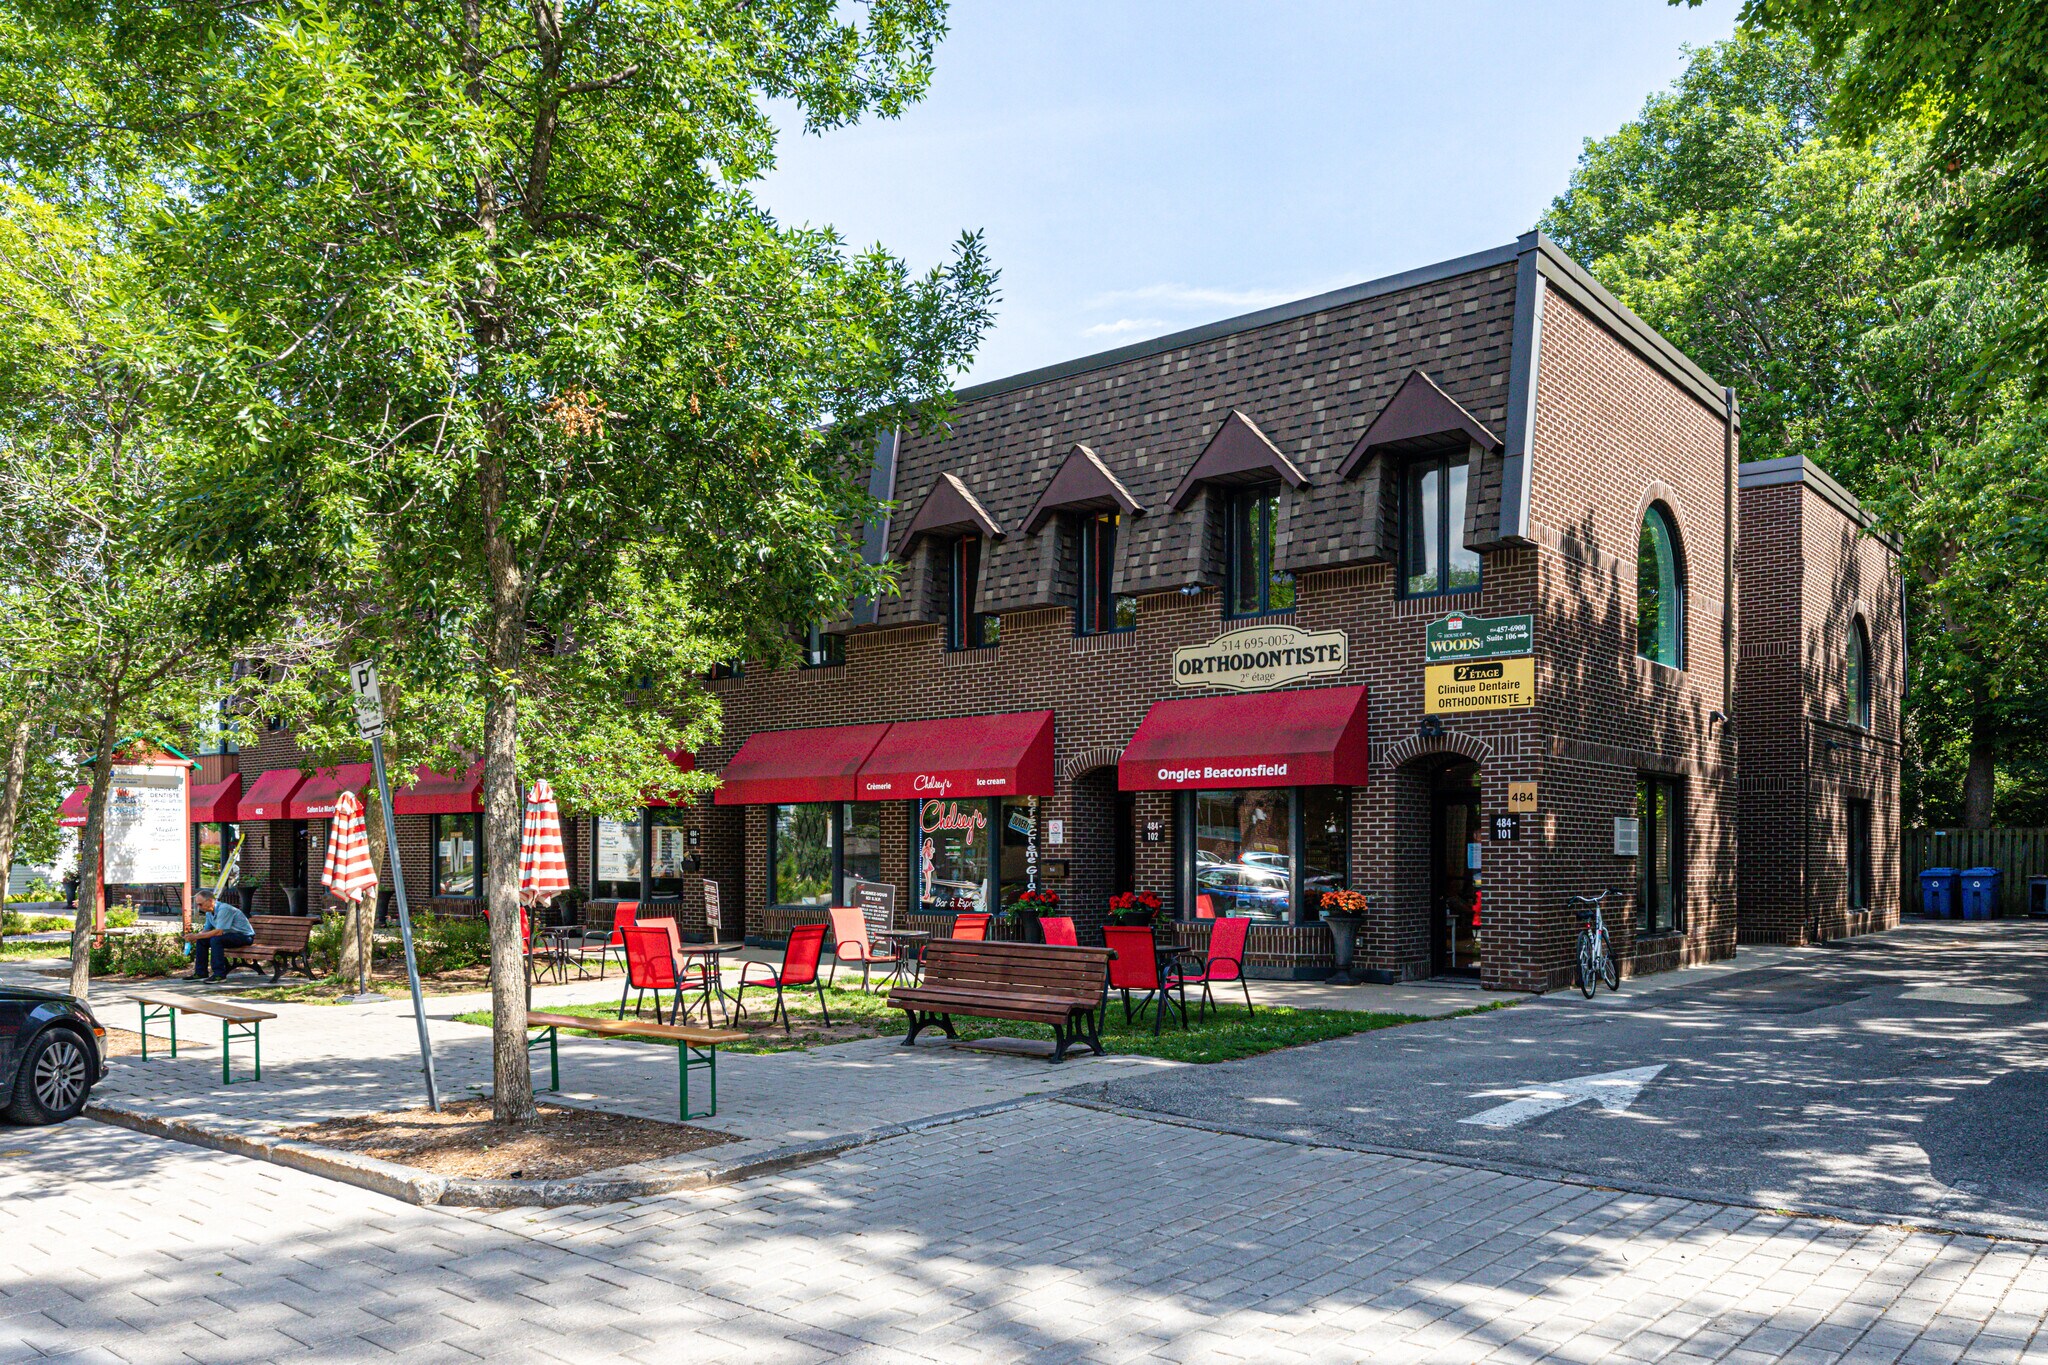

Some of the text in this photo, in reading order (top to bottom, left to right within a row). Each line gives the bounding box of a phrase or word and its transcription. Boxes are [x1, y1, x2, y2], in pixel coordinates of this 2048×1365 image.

[1221, 634, 1295, 652] 514 695-0052
[1430, 637, 1480, 653] WOODS
[1178, 644, 1342, 676] ORTHODONTISTE
[1251, 672, 1276, 683] étage
[1470, 668, 1500, 679] ÉTAGE
[358, 669, 368, 694] P
[1438, 680, 1520, 695] Clinique Dentaire
[1438, 694, 1520, 708] ORTHODONTISTE
[1158, 764, 1288, 782] Ongles Beaconsfield
[914, 774, 952, 796] Chelsey's
[1512, 792, 1534, 802] 484
[920, 800, 987, 845] Chelsey's
[1146, 822, 1163, 831] 484-
[1496, 818, 1517, 828] 484-
[1147, 832, 1159, 841] 102
[1497, 830, 1512, 839] 101
[935, 897, 948, 908] Bar
[950, 896, 954, 908] à
